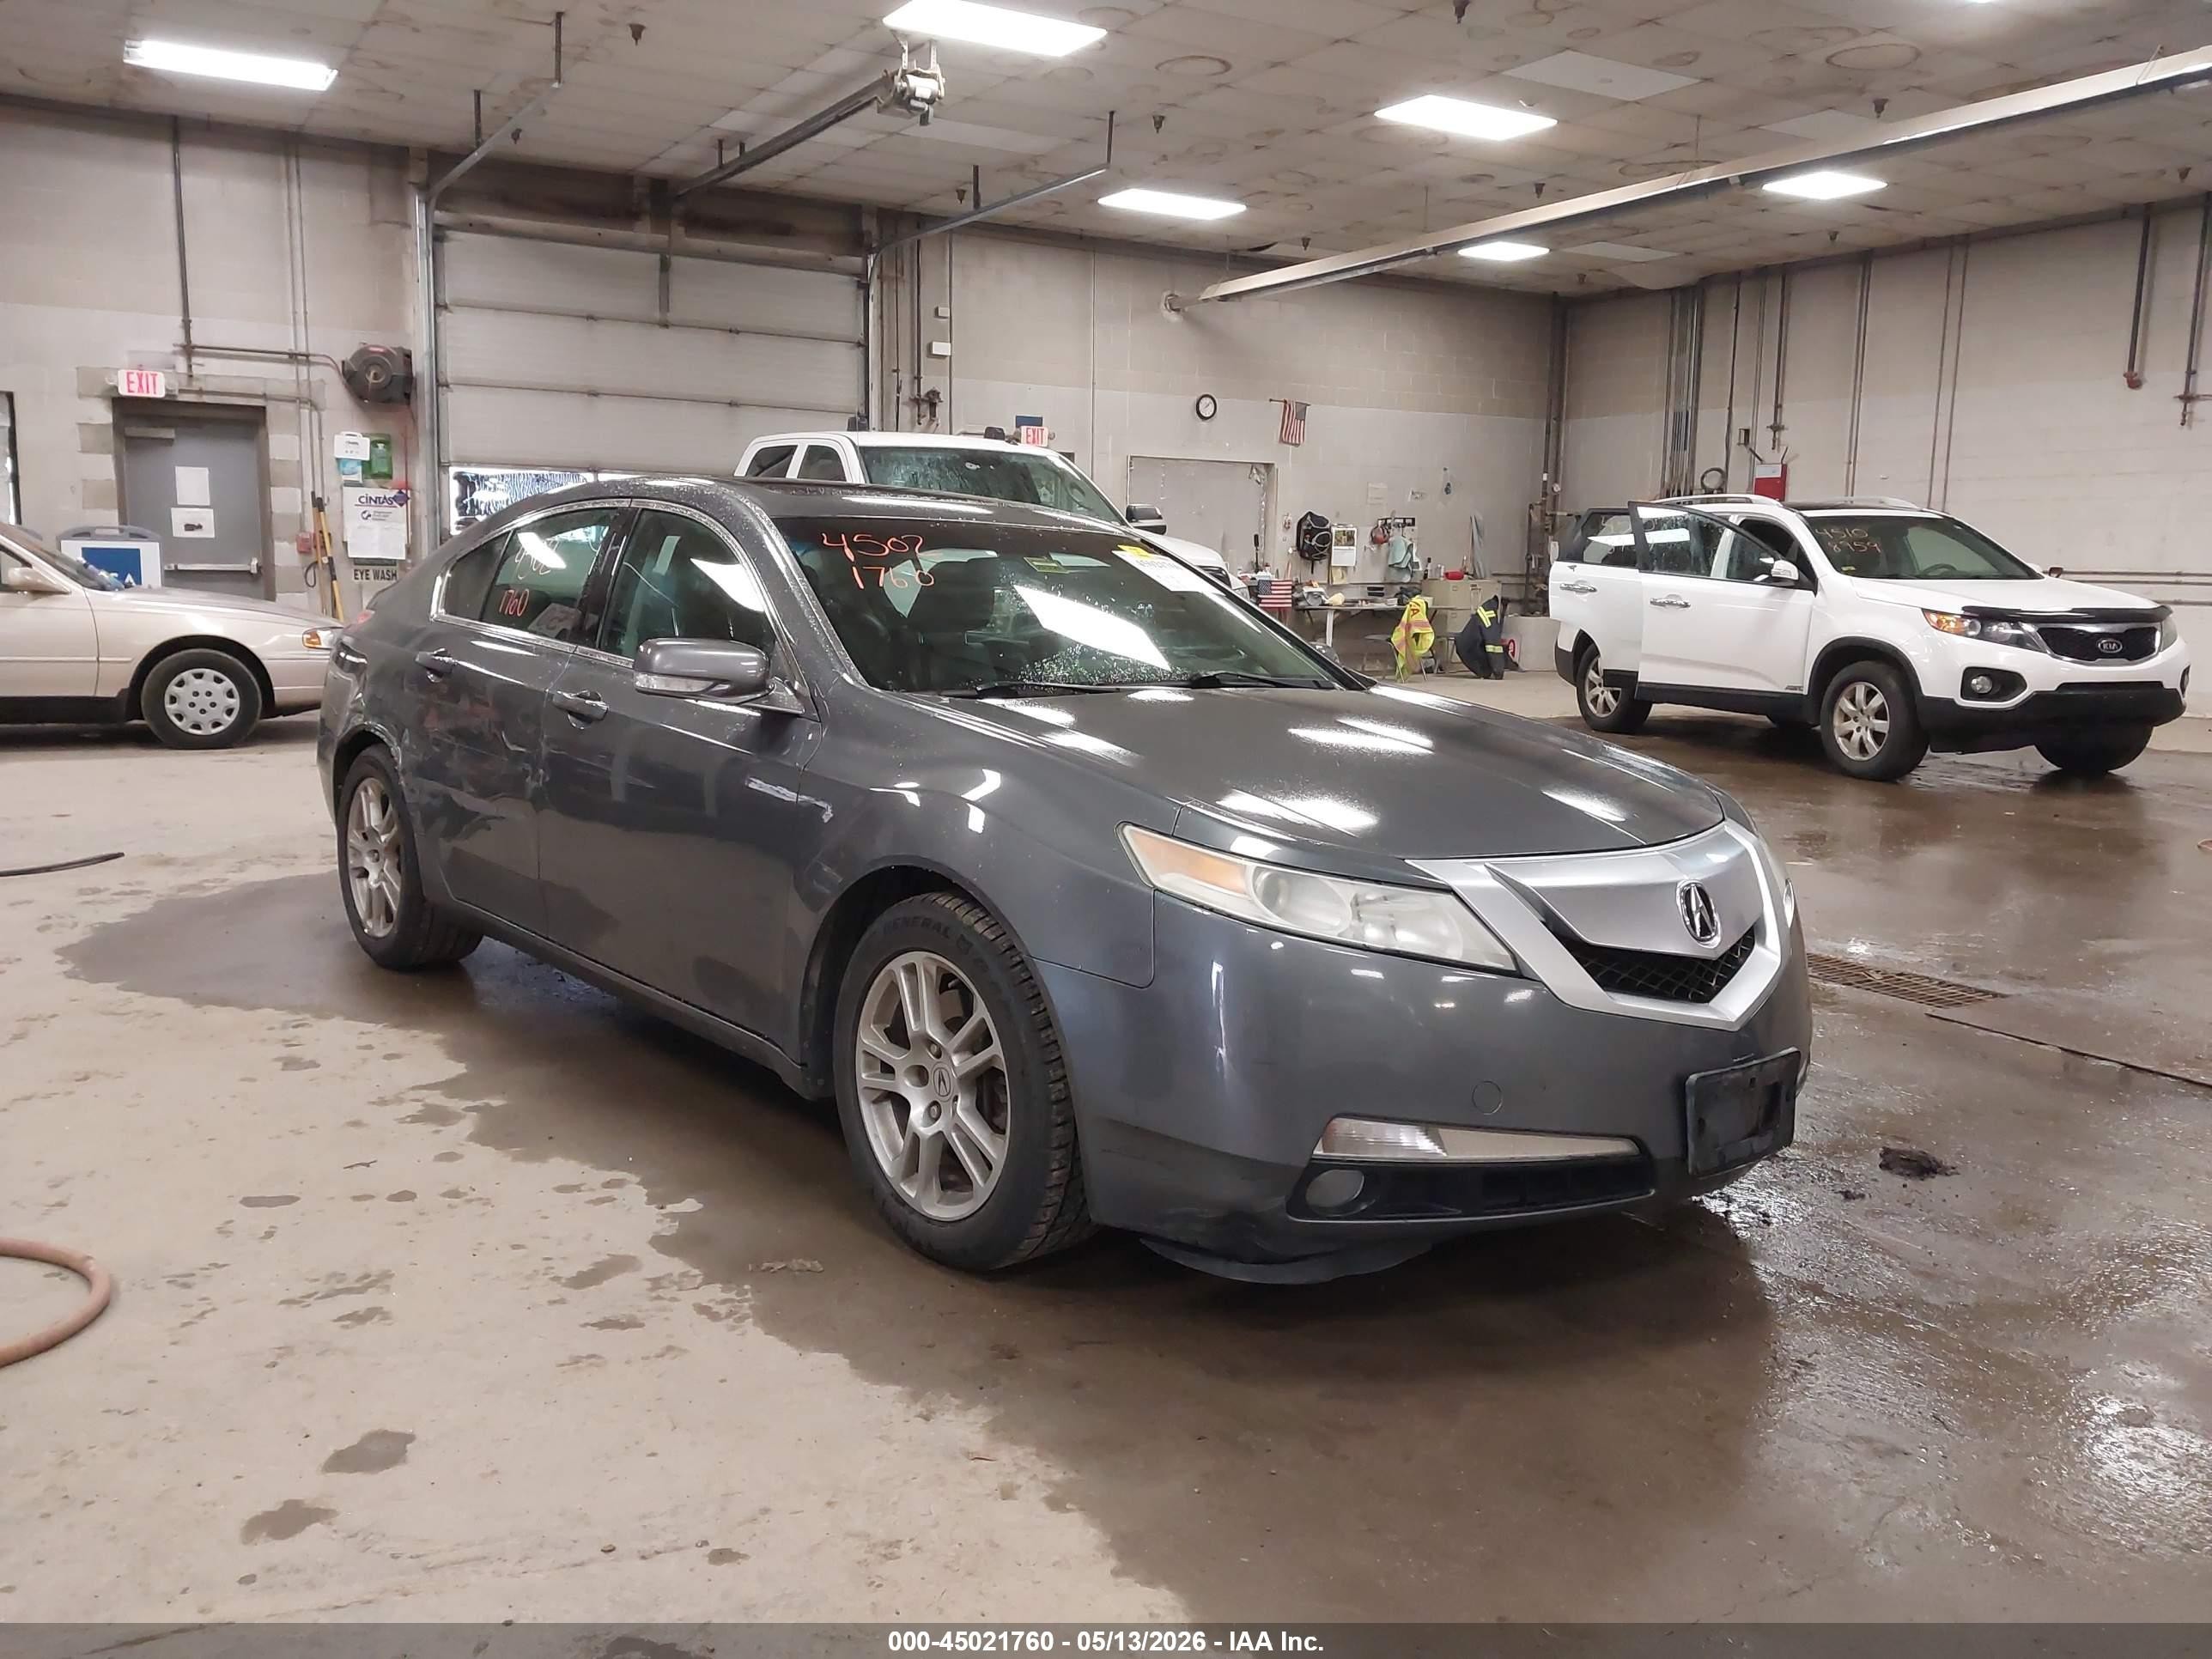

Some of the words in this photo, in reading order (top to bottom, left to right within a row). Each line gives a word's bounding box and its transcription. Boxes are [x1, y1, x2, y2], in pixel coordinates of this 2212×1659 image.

[126, 372, 157, 395] EXIT
[1026, 428, 1045, 445] EXIT
[357, 494, 394, 506] CINTAS
[353, 568, 371, 580] EYE
[372, 568, 398, 581] WASH
[852, 566, 935, 590] 1760
[499, 588, 530, 617] 1760
